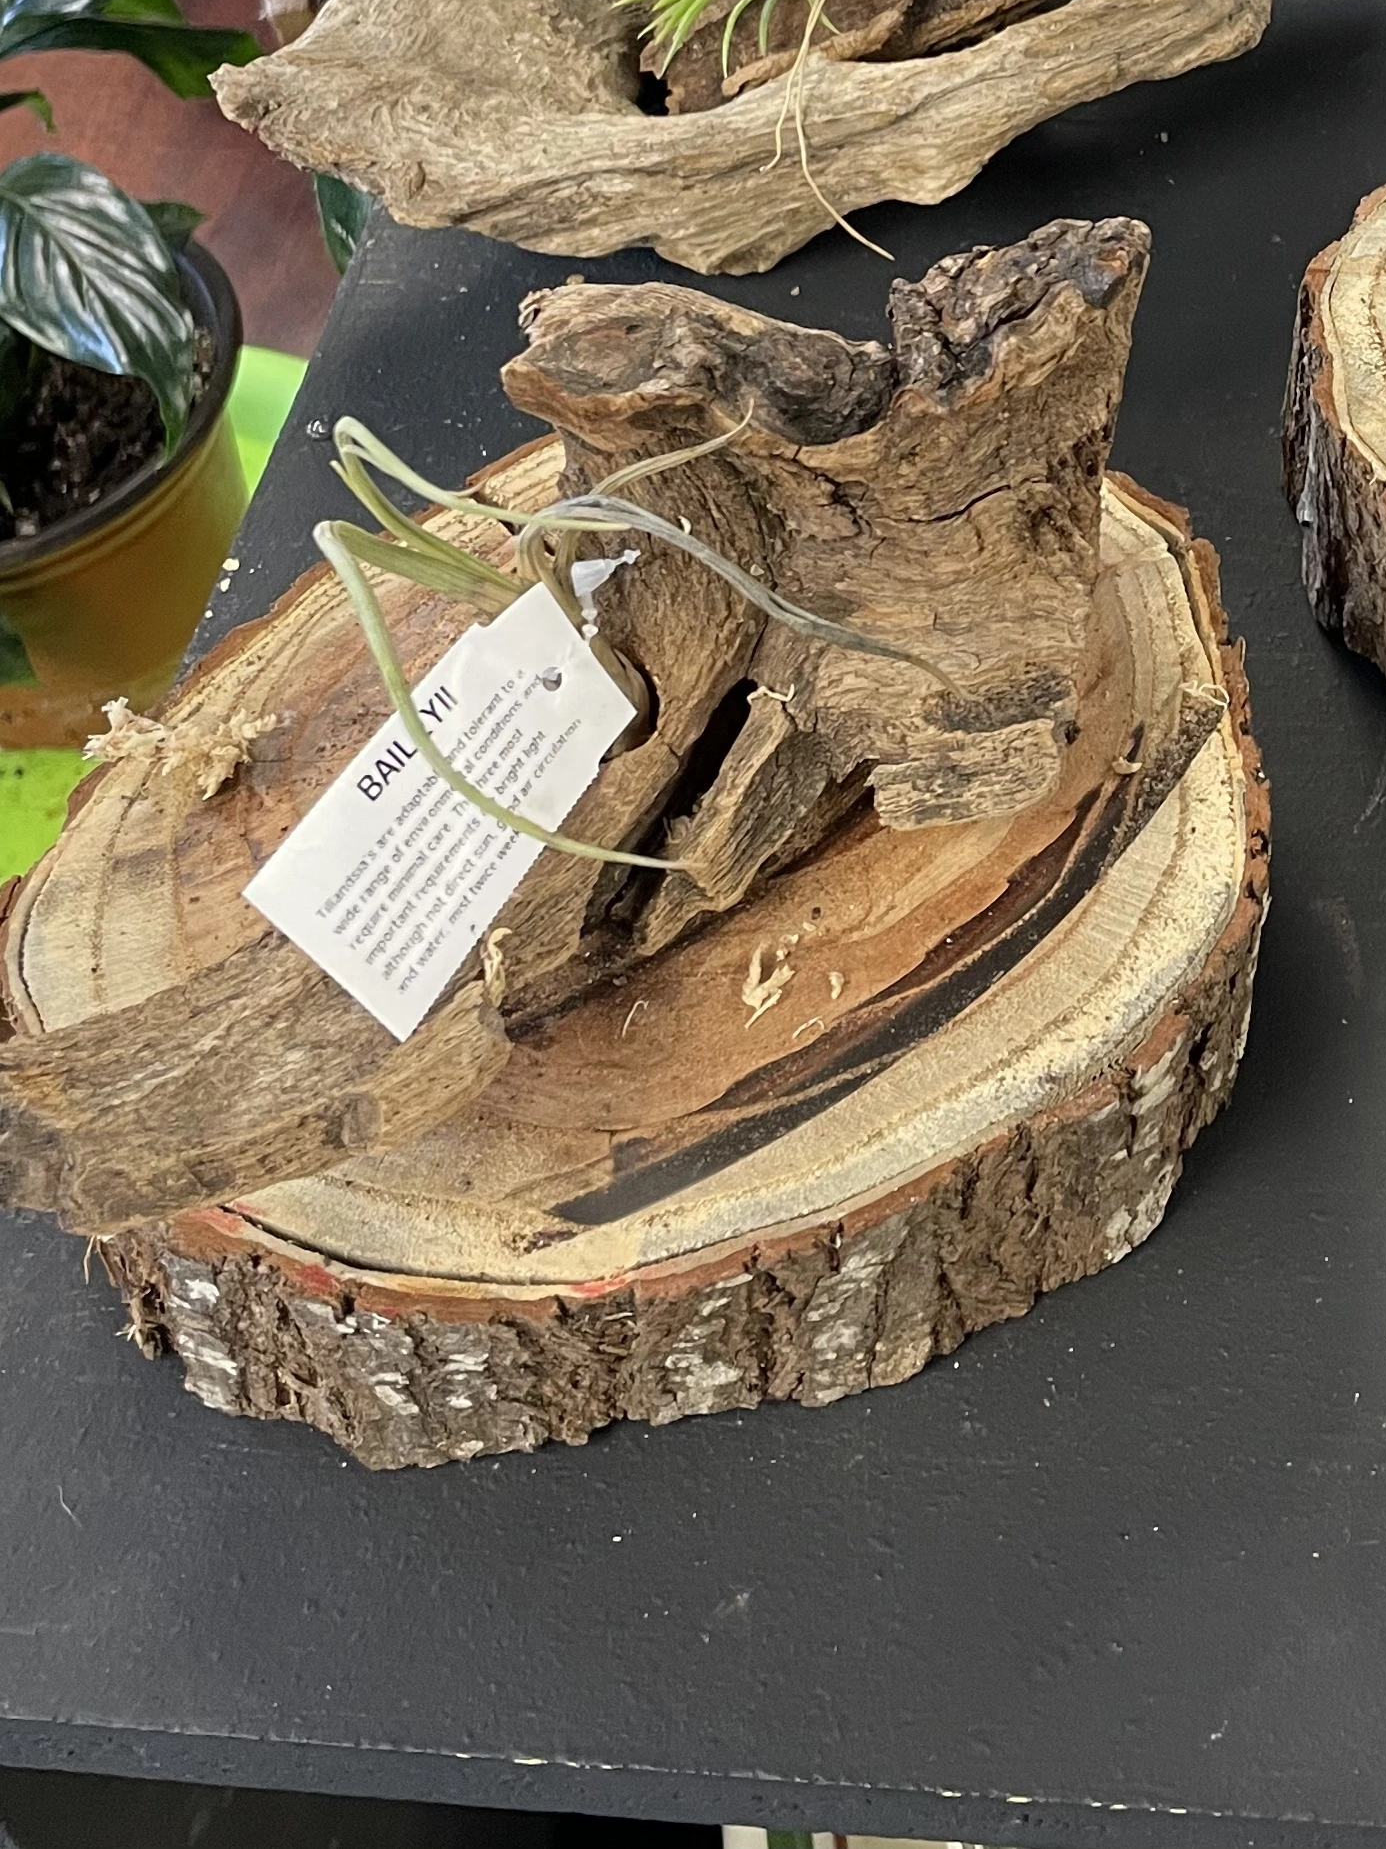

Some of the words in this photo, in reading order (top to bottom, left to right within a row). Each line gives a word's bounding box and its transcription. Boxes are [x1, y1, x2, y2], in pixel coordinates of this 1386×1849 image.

[331, 902, 362, 936] wide
[358, 863, 394, 904] range
[389, 844, 405, 863] of
[471, 699, 524, 761] conditions
[347, 902, 391, 951] require
[385, 849, 430, 902] minimal
[450, 798, 471, 818] Th
[474, 759, 501, 789] hree
[496, 727, 525, 761] most
[355, 684, 459, 802] BAILYII
[375, 826, 396, 850] are
[462, 692, 504, 741] tolerant
[500, 678, 516, 694] to
[362, 899, 419, 966] important
[411, 815, 484, 901] requirements
[492, 756, 527, 796] bright
[379, 920, 429, 981] although
[423, 896, 447, 922] not
[442, 857, 477, 897] direct
[518, 778, 534, 797] air
[446, 894, 473, 925] mist
[467, 860, 498, 896] twice
